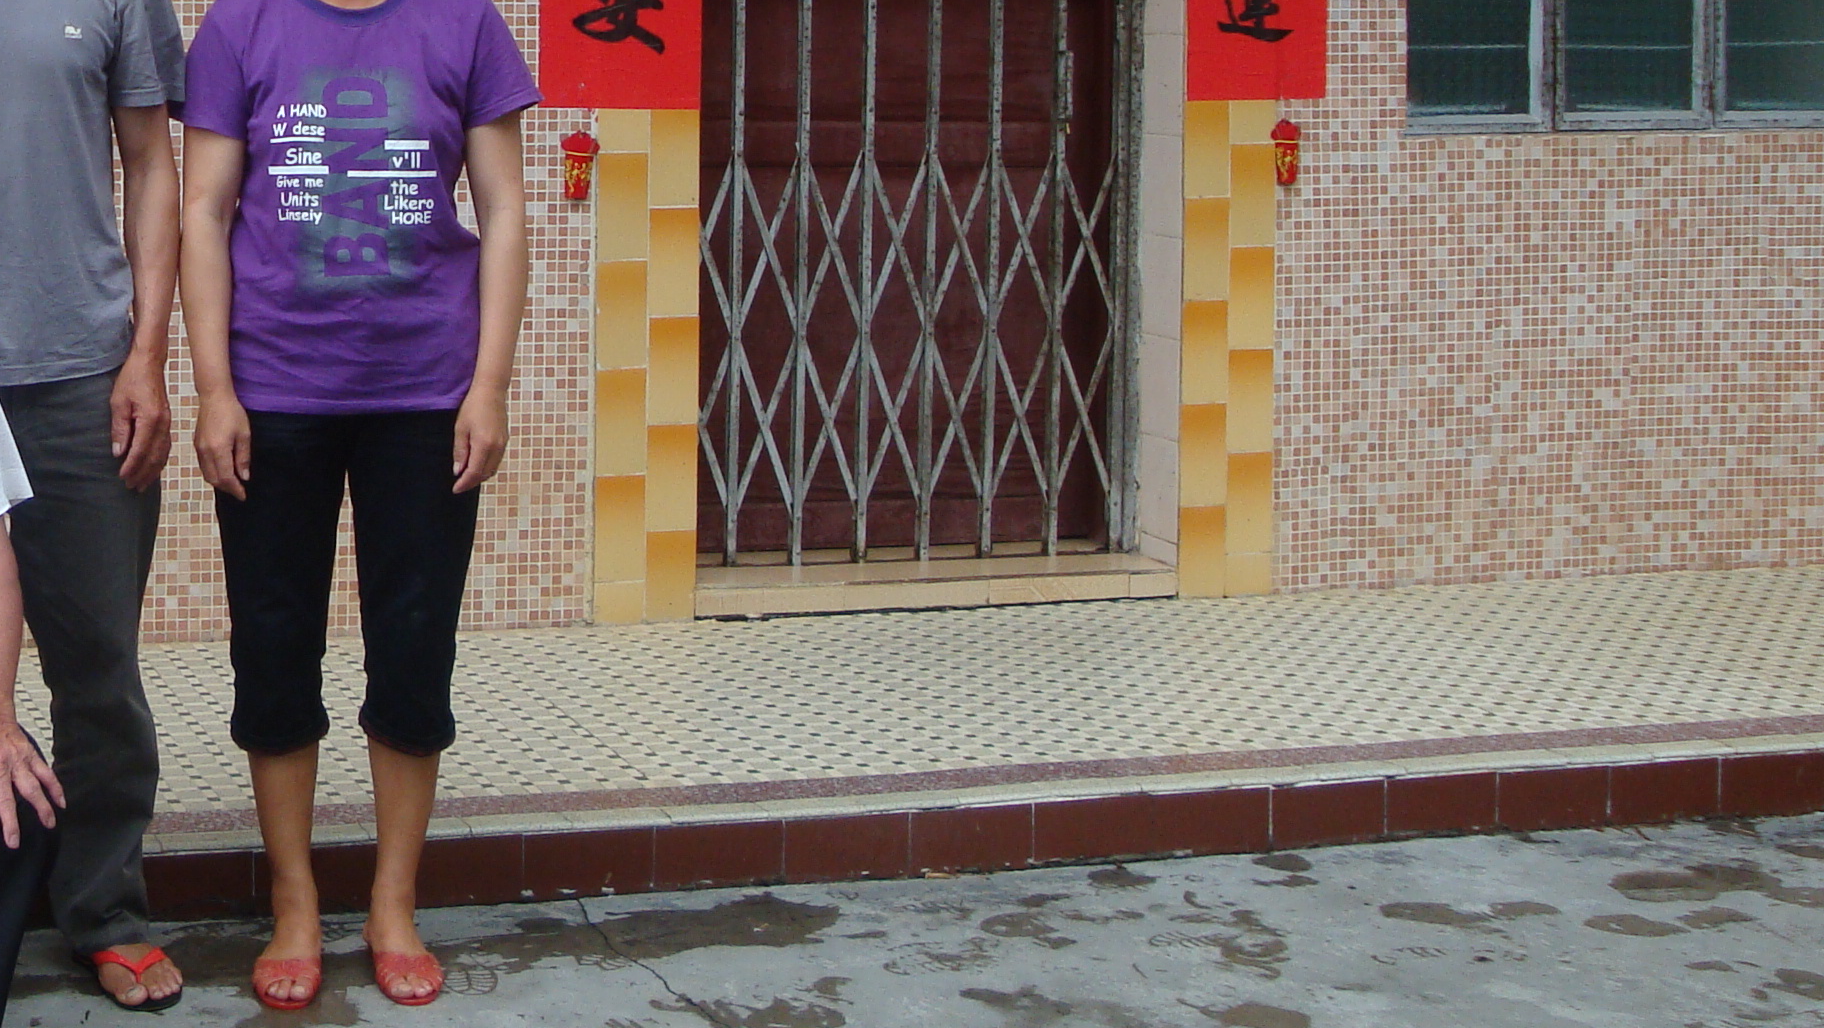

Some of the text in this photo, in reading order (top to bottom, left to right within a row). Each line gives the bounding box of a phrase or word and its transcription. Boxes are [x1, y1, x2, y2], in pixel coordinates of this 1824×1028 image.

[276, 103, 327, 119] A HAND
[272, 121, 326, 137] W dese
[285, 148, 323, 165] Sine
[276, 176, 324, 188] Give me
[322, 75, 391, 277] BAND
[390, 179, 419, 195] the
[280, 192, 320, 208] Units
[384, 195, 435, 211] Likero
[391, 211, 432, 225] HORE
